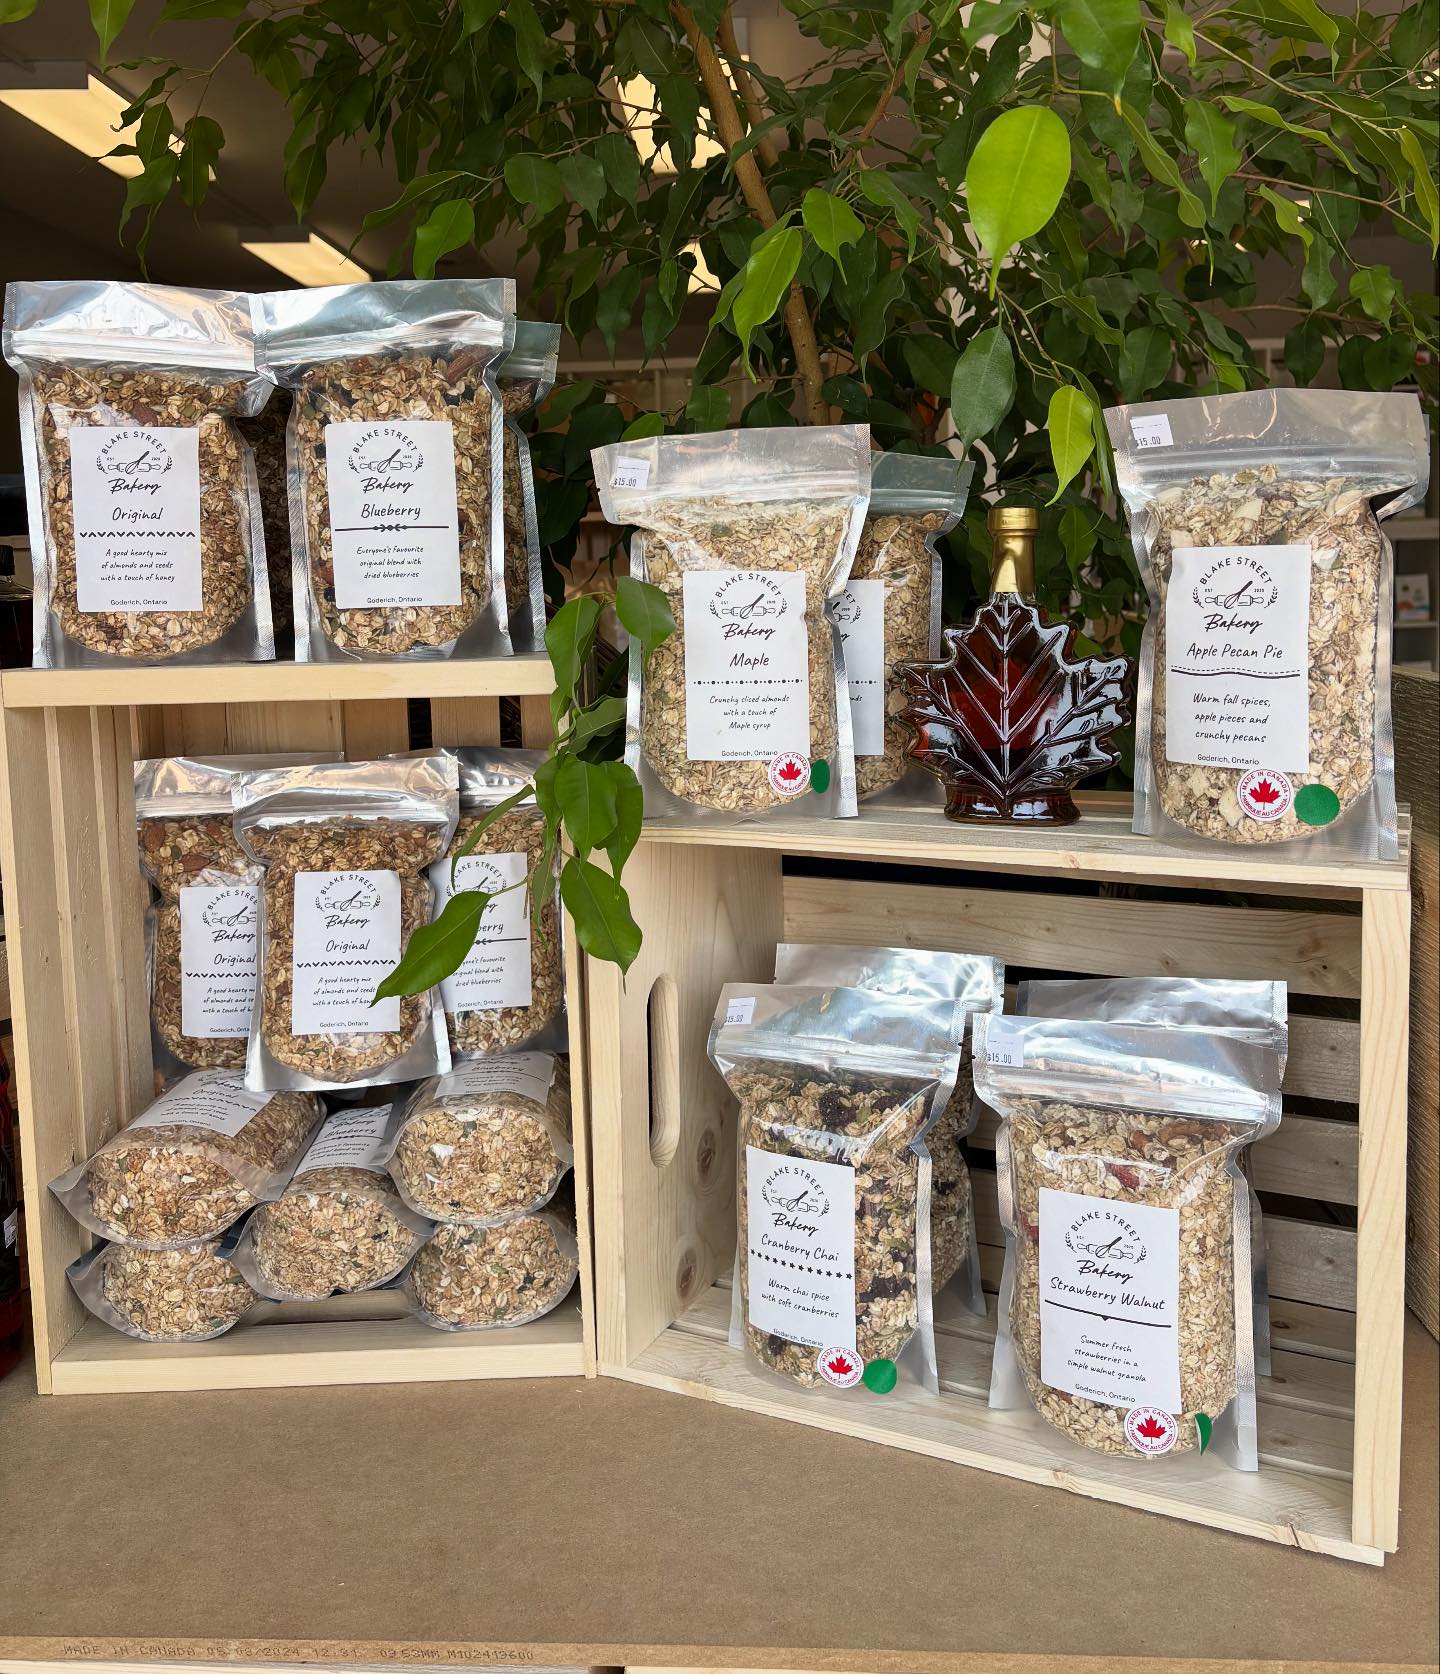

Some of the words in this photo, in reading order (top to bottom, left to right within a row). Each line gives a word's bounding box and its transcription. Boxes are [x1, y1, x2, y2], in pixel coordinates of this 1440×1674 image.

[102, 432, 128, 454] BLAKE
[133, 431, 166, 454] STREET
[353, 430, 379, 453] BLAKE
[384, 429, 418, 451] STREET
[108, 478, 161, 495] Bakery
[361, 477, 413, 493] Bakery
[112, 507, 163, 523] Original
[361, 504, 420, 520] Blueberry
[357, 546, 391, 555] Everyone's
[360, 559, 385, 568] original
[1200, 558, 1230, 585] BLAKE
[1237, 557, 1272, 584] STREET
[715, 574, 743, 598] BLAKE
[748, 573, 781, 596] STREET
[722, 623, 776, 640] Bakery
[1204, 613, 1263, 634] Bakery
[1187, 642, 1218, 659] Apple
[1222, 644, 1258, 658] Pecan
[1264, 645, 1283, 658] Pie
[730, 653, 769, 670] Maple
[710, 696, 738, 704] Crunchy
[1193, 694, 1220, 703] Warm
[1224, 694, 1239, 705] fall
[1241, 696, 1270, 707] spices,
[1195, 712, 1216, 724] apple
[1219, 713, 1246, 724] pieces
[1250, 715, 1268, 724] and
[1195, 731, 1230, 743] crunchy
[1234, 734, 1266, 744] pecans
[1198, 754, 1230, 763] Goderich,
[1232, 757, 1259, 765] Ontario
[1266, 772, 1288, 794] CANADA
[455, 862, 471, 878] LAKE
[476, 861, 502, 878] STREET
[321, 876, 344, 894] BLAKE
[349, 875, 376, 893] STREET
[208, 891, 230, 910] BLAKE
[235, 890, 258, 904] STREE
[325, 914, 370, 929] Bakery
[326, 939, 370, 953] Original
[214, 954, 256, 966] Original
[766, 1167, 789, 1185] BLAKE
[794, 1168, 824, 1196] STREET
[772, 1212, 819, 1237] Bakery
[1071, 1212, 1100, 1232] BLAKE
[1106, 1212, 1140, 1241] STREET
[761, 1234, 810, 1260] Cranberry
[814, 1248, 839, 1261] Chai
[1076, 1259, 1133, 1284] Bakery
[769, 1278, 790, 1292] Warm
[792, 1286, 809, 1296] chai
[811, 1291, 829, 1301] spice
[1050, 1277, 1116, 1304] Strawberry
[1121, 1292, 1165, 1310] Walnut
[762, 1293, 775, 1302] with
[778, 1298, 792, 1308] soft
[794, 1303, 839, 1318] cranberries
[801, 1337, 823, 1347] Ontario
[1081, 1335, 1109, 1348] Summer
[1112, 1341, 1132, 1352] fresh
[1075, 1349, 1121, 1365] strawberries
[1067, 1360, 1089, 1371] simple
[1090, 1364, 1116, 1377] walnut
[1118, 1372, 1146, 1382] granola
[1075, 1384, 1107, 1398] Goderich,
[1109, 1391, 1136, 1402] Ontario
[1152, 1410, 1173, 1430] CANADA
[63, 1645, 101, 1656] MADE
[140, 1646, 196, 1657] CANADA
